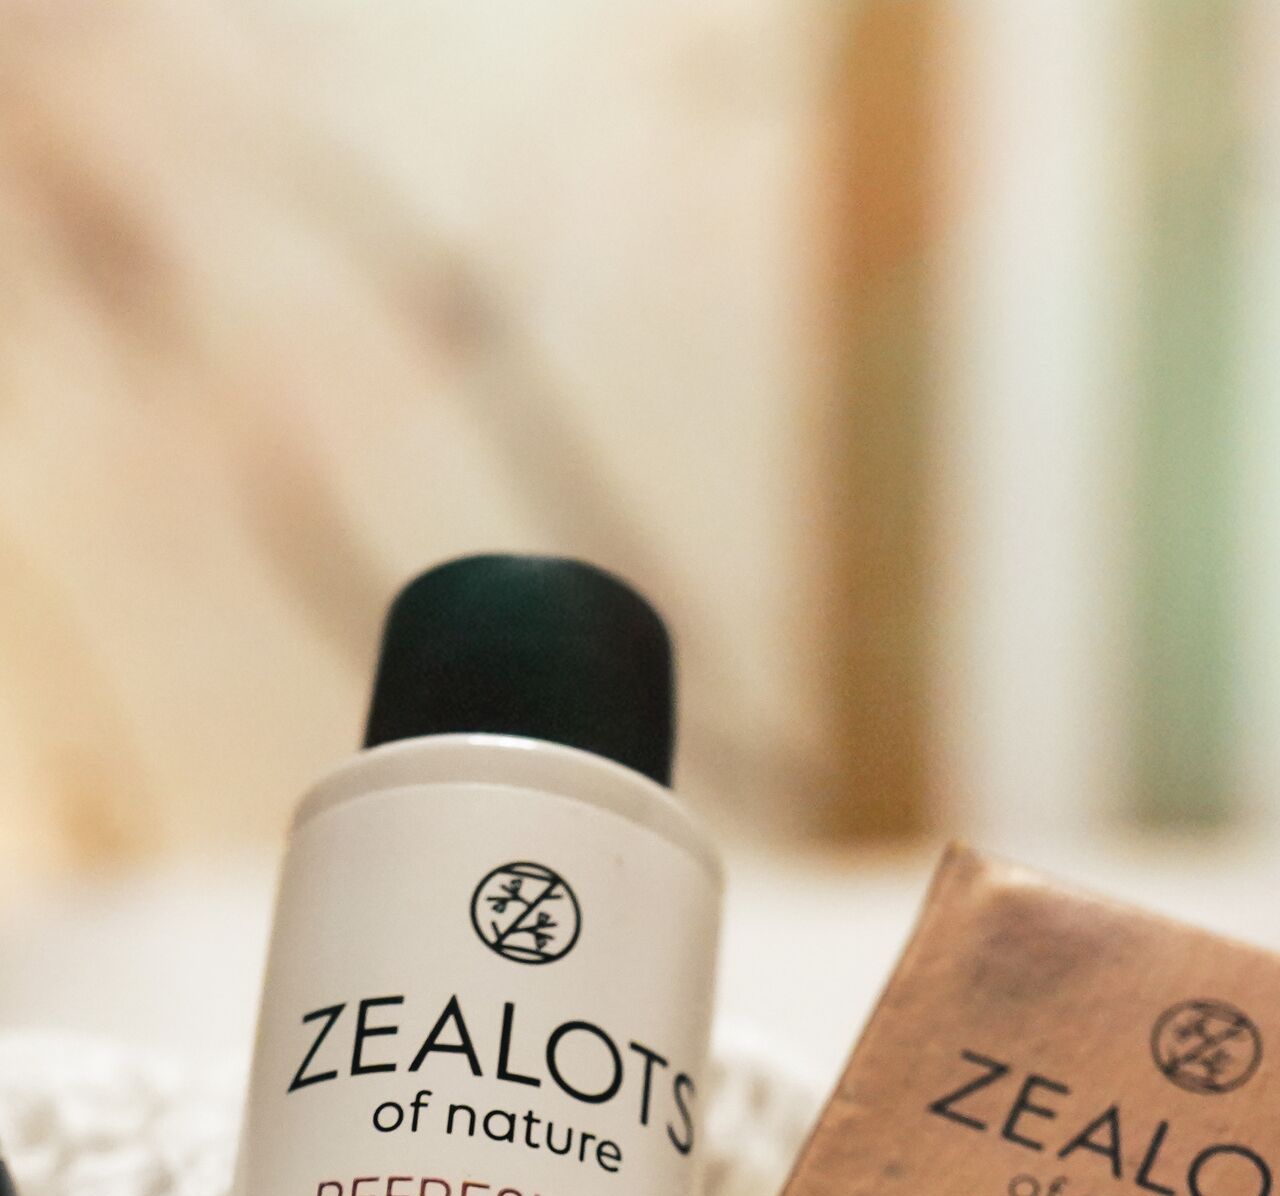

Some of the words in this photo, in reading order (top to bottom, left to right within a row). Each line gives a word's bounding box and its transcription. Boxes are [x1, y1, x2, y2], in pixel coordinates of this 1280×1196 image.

[286, 993, 699, 1156] ZEALOTS
[372, 1089, 433, 1133] of
[445, 1102, 624, 1173] nature
